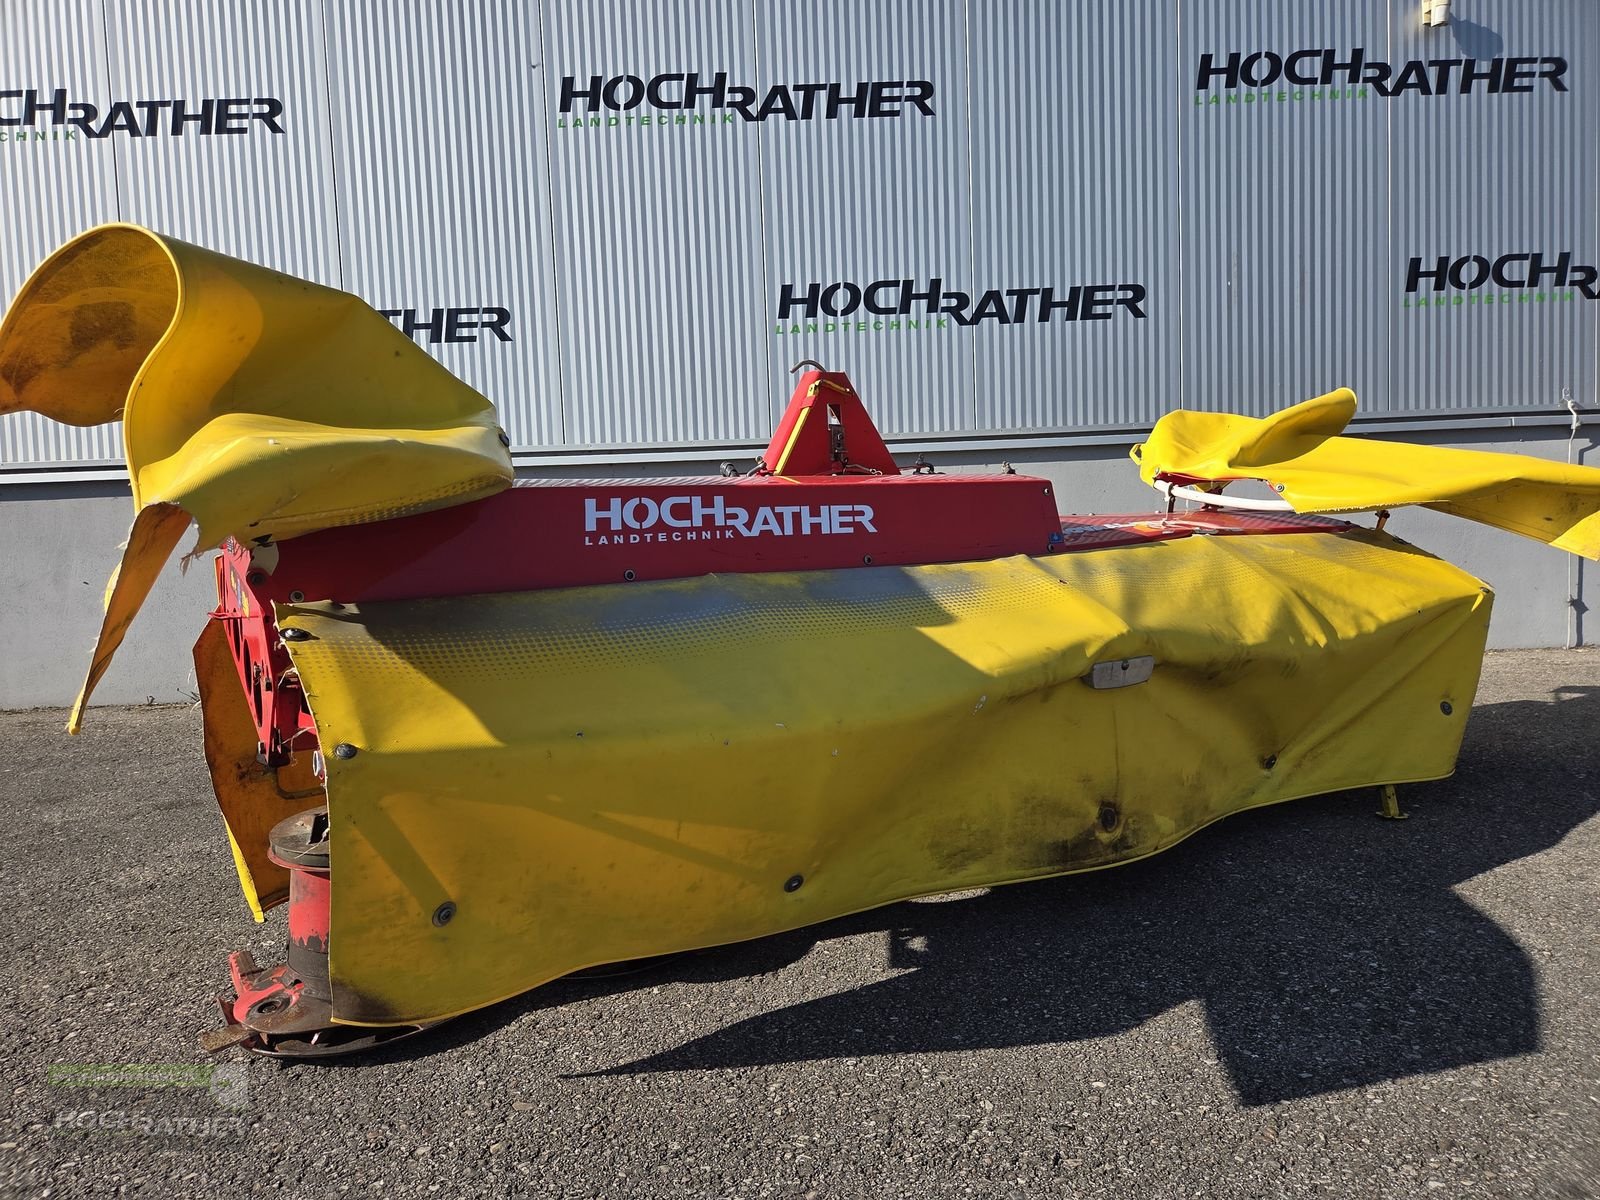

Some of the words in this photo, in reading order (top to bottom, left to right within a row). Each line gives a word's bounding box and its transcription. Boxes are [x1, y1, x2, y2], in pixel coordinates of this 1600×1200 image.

[1196, 47, 1568, 98] HOCHRATHER
[559, 72, 936, 122] HOCHRATHER
[1194, 88, 1368, 106] LANDTECHNIK
[557, 111, 736, 129] LANDTECHNIK
[1405, 251, 1600, 300] HOCHR
[777, 278, 1147, 326] HOCHRATHER
[1402, 291, 1577, 309] LANDTECHNIK
[774, 318, 948, 336] LANDTECHNIK
[584, 495, 878, 537] HOCHRATHER
[584, 529, 735, 546] LANDTECHNIK
